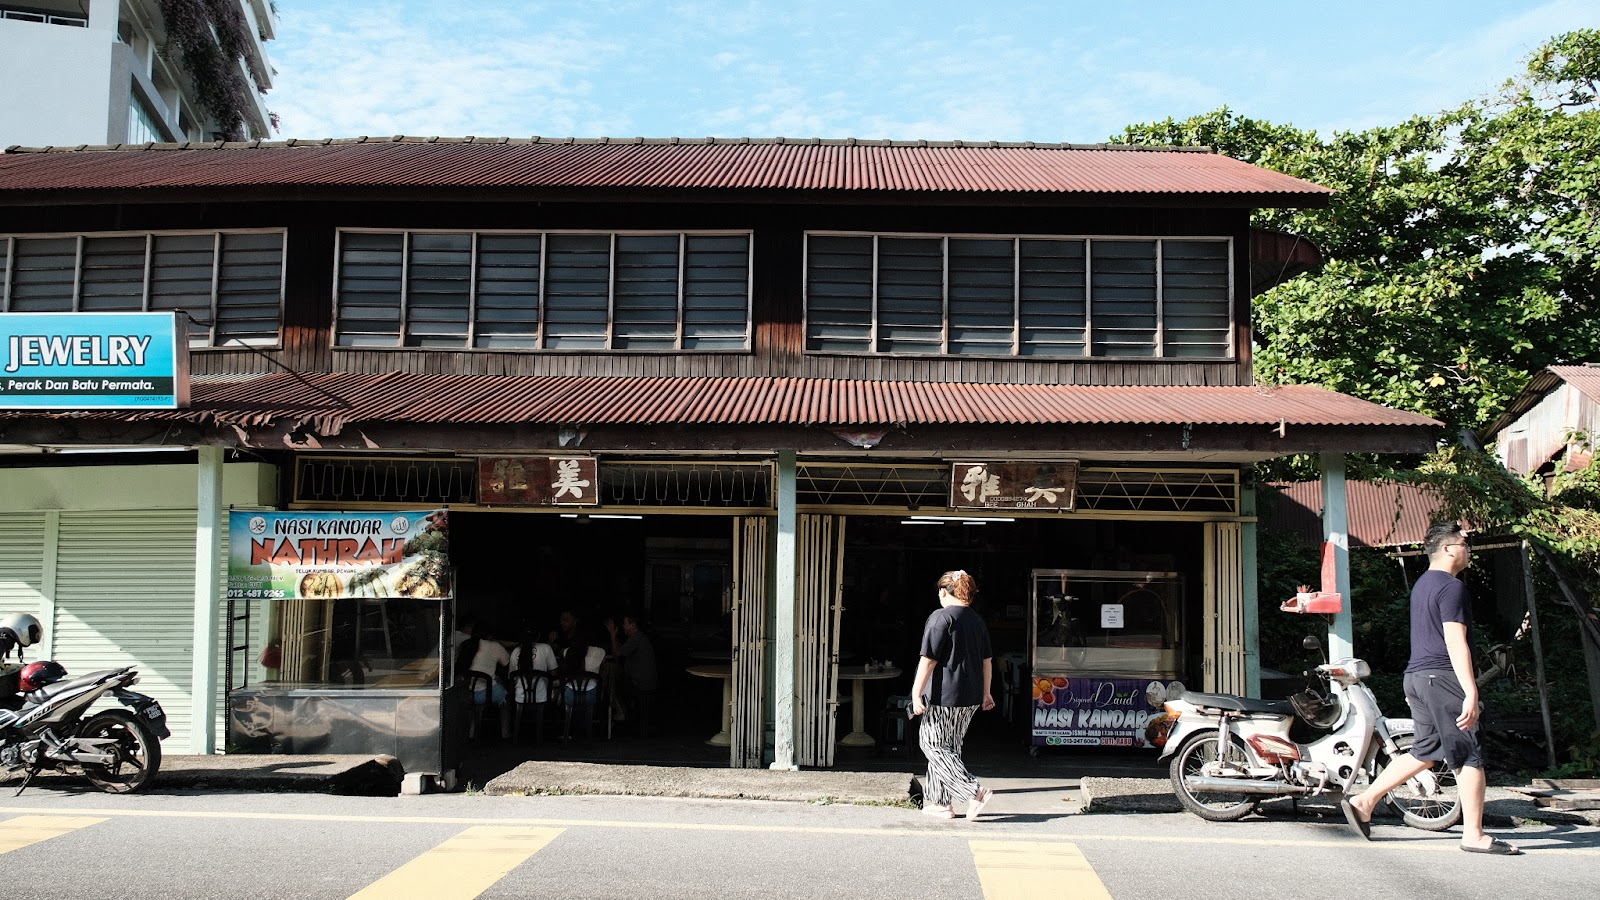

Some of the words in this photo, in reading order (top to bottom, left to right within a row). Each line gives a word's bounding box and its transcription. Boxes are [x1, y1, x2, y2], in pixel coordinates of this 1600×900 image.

[5, 335, 152, 372] JEWELRY
[8, 380, 42, 391] Perak
[45, 380, 69, 390] Dan
[72, 380, 99, 390] Batu
[101, 380, 155, 391] Permata.
[274, 519, 312, 535] NASI
[317, 519, 382, 535] KANDAR
[251, 536, 405, 566] NATHRAH
[1095, 682, 1139, 707] Daud
[1034, 708, 1075, 728] NASI
[1078, 709, 1149, 729] KANDAR
